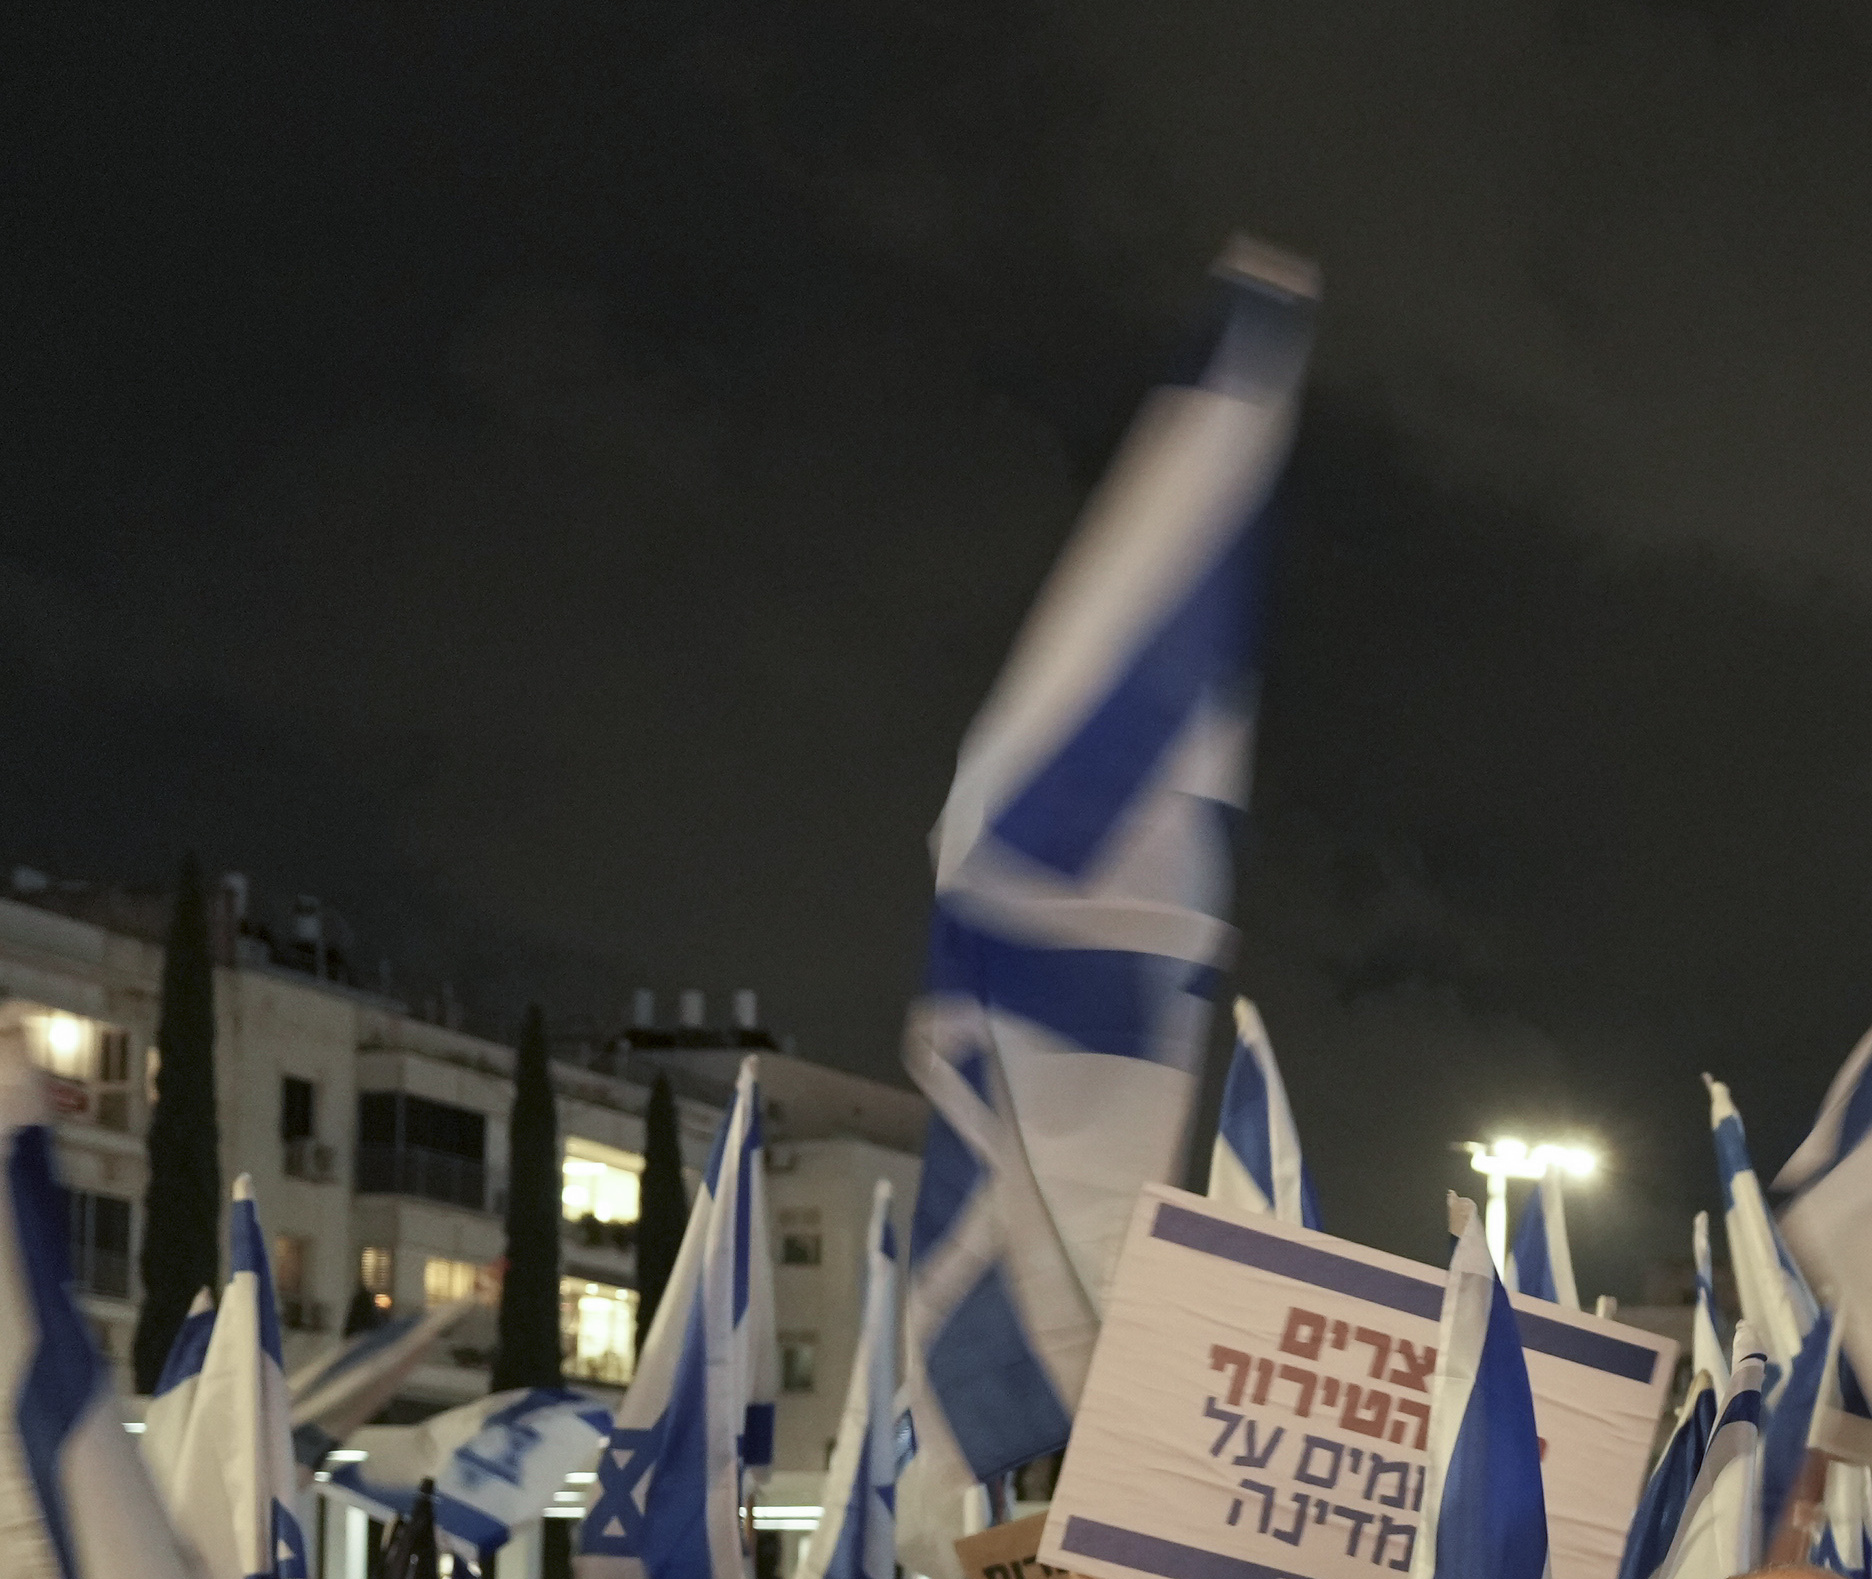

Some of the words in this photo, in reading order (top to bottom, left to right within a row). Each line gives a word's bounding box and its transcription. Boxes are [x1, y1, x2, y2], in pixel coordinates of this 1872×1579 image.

[1278, 1306, 1439, 1393] צרים
[1203, 1395, 1286, 1469] על
[1226, 1478, 1418, 1573] מדינה
